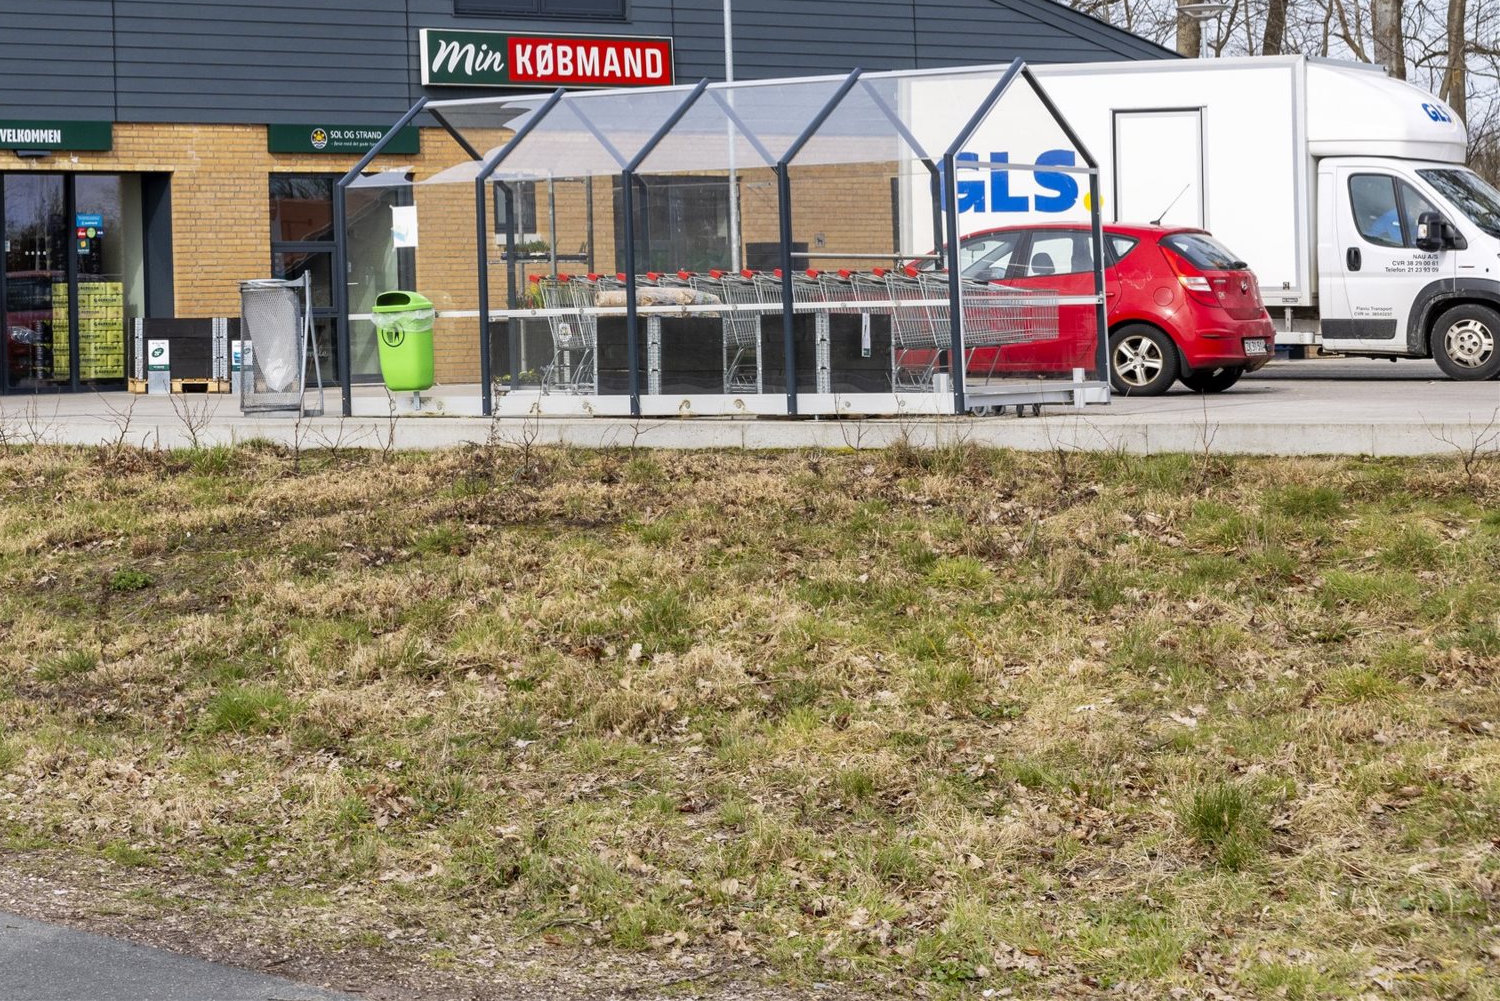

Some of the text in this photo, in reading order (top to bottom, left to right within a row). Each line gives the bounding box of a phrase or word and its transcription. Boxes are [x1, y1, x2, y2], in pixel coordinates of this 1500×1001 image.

[431, 39, 663, 79] Min KØBMAND
[0, 128, 61, 143] VELKOMMEN
[330, 130, 382, 139] SOL OG STRAND
